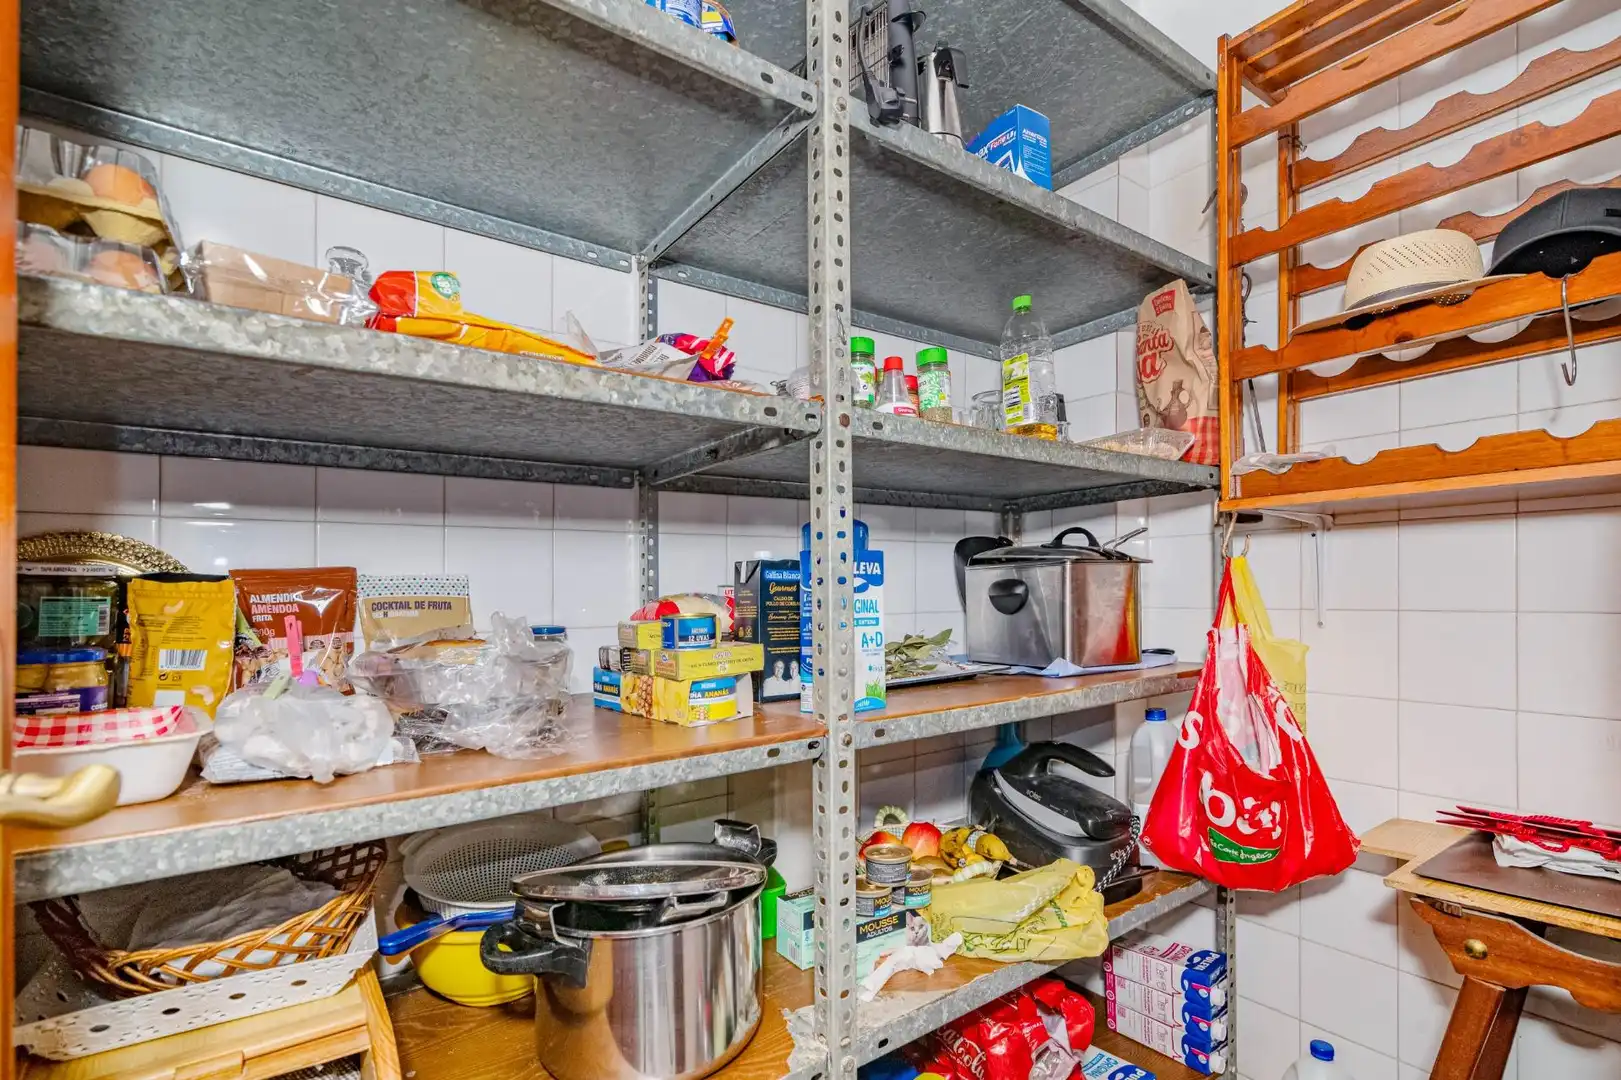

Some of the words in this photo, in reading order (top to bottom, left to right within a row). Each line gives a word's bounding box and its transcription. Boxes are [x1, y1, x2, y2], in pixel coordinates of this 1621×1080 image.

[769, 582, 797, 594] Gourmet
[371, 601, 412, 612] COCKTAIL
[414, 601, 425, 611] DE
[428, 601, 452, 611] FRUTA
[252, 614, 273, 622] FRITA
[862, 632, 883, 648] A+D
[705, 689, 729, 698] ANANÁS
[860, 915, 899, 935] MOUSSE
[866, 926, 893, 939] ADULTOS
[1196, 952, 1221, 971] PULEVA
